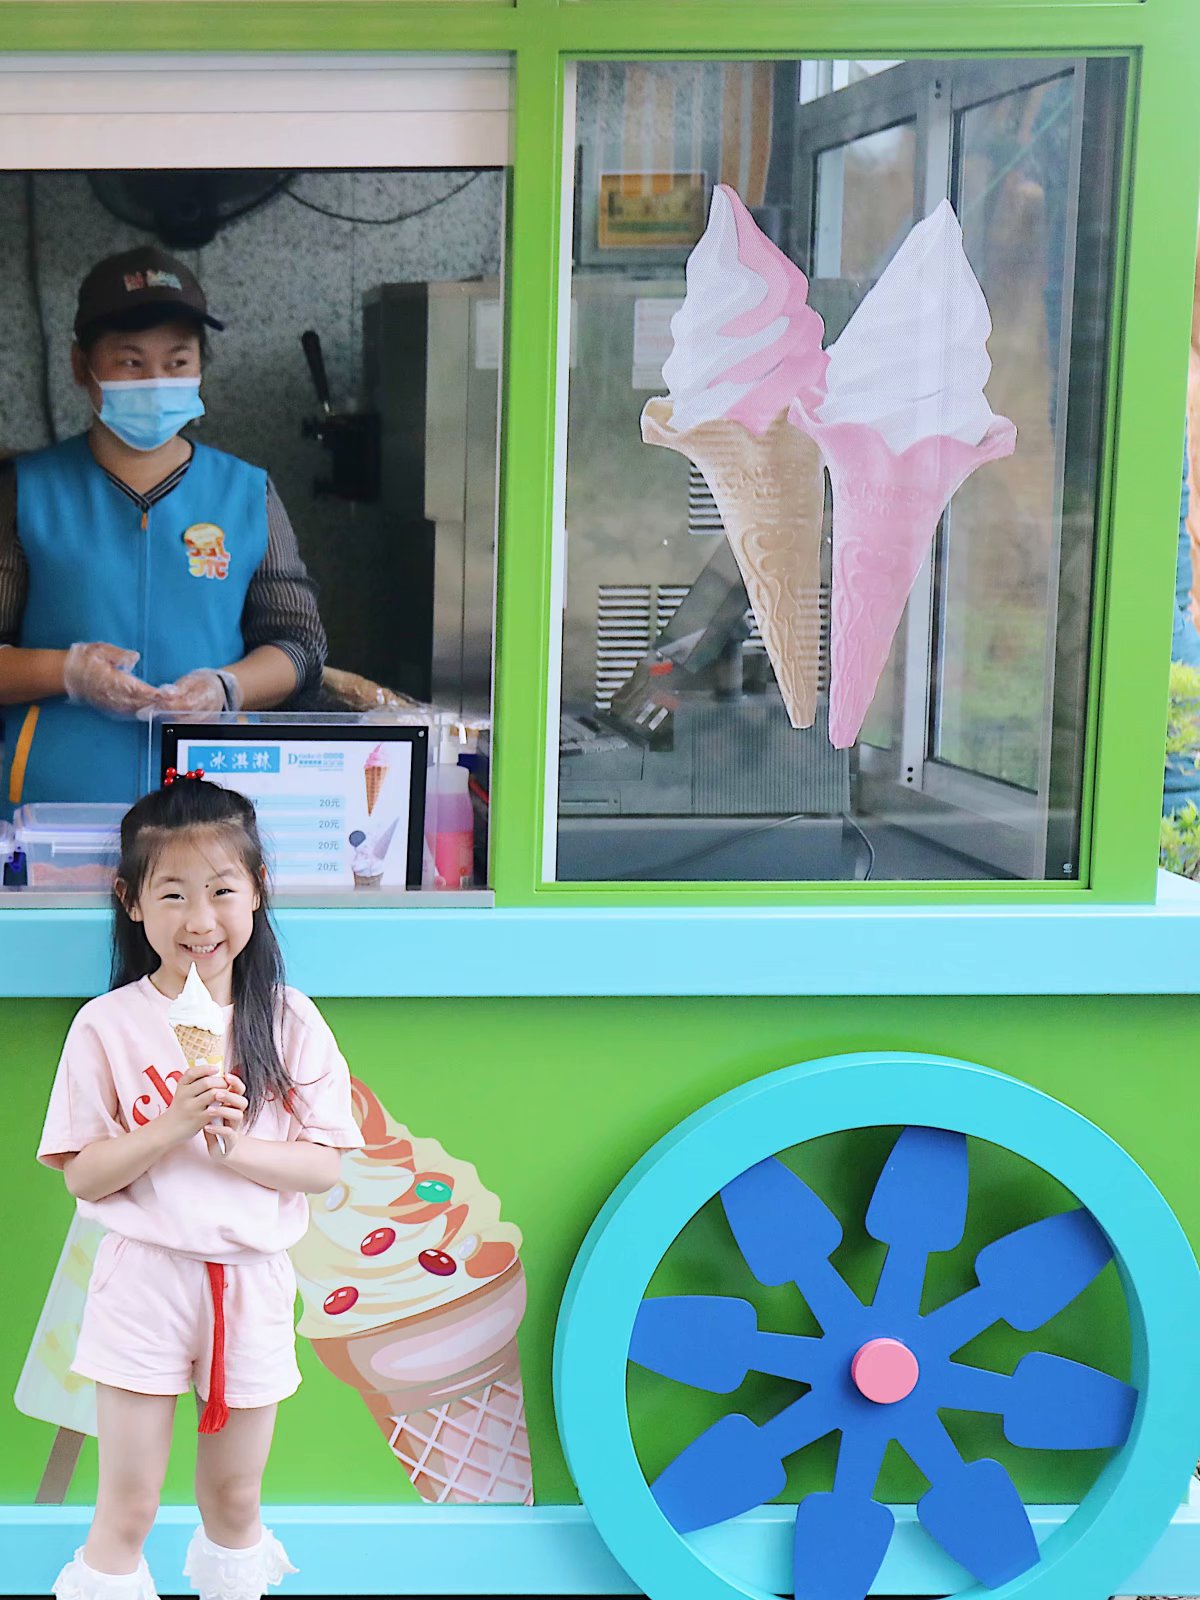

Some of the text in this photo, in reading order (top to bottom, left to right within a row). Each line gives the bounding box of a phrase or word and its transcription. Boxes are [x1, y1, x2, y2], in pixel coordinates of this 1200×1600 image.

[209, 751, 273, 771] 冰淇淋
[319, 799, 341, 808] 20元
[319, 820, 340, 829] 20元
[318, 841, 340, 850] 20元
[317, 862, 339, 872] 20元
